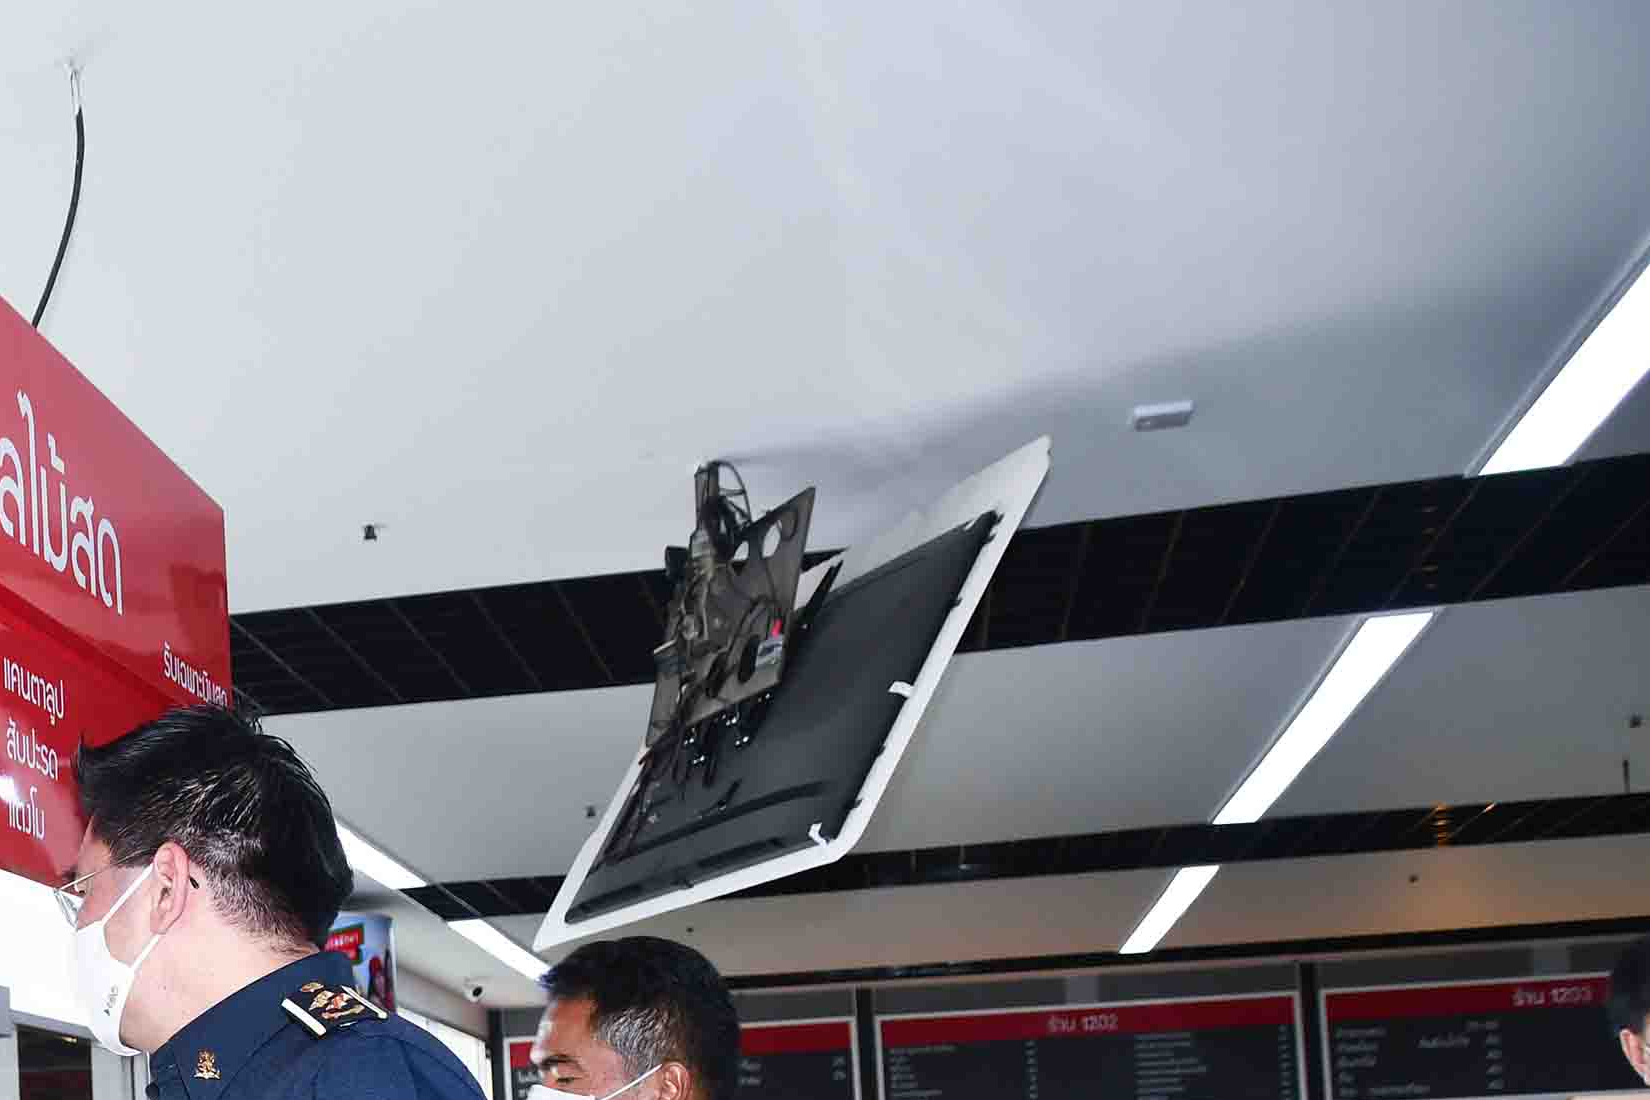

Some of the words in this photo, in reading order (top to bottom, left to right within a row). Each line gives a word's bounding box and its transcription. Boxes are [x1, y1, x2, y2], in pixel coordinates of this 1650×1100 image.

[2, 656, 64, 727] แคนตาลูป
[6, 716, 58, 782] สับปะรด
[7, 785, 45, 840] แตงโม
